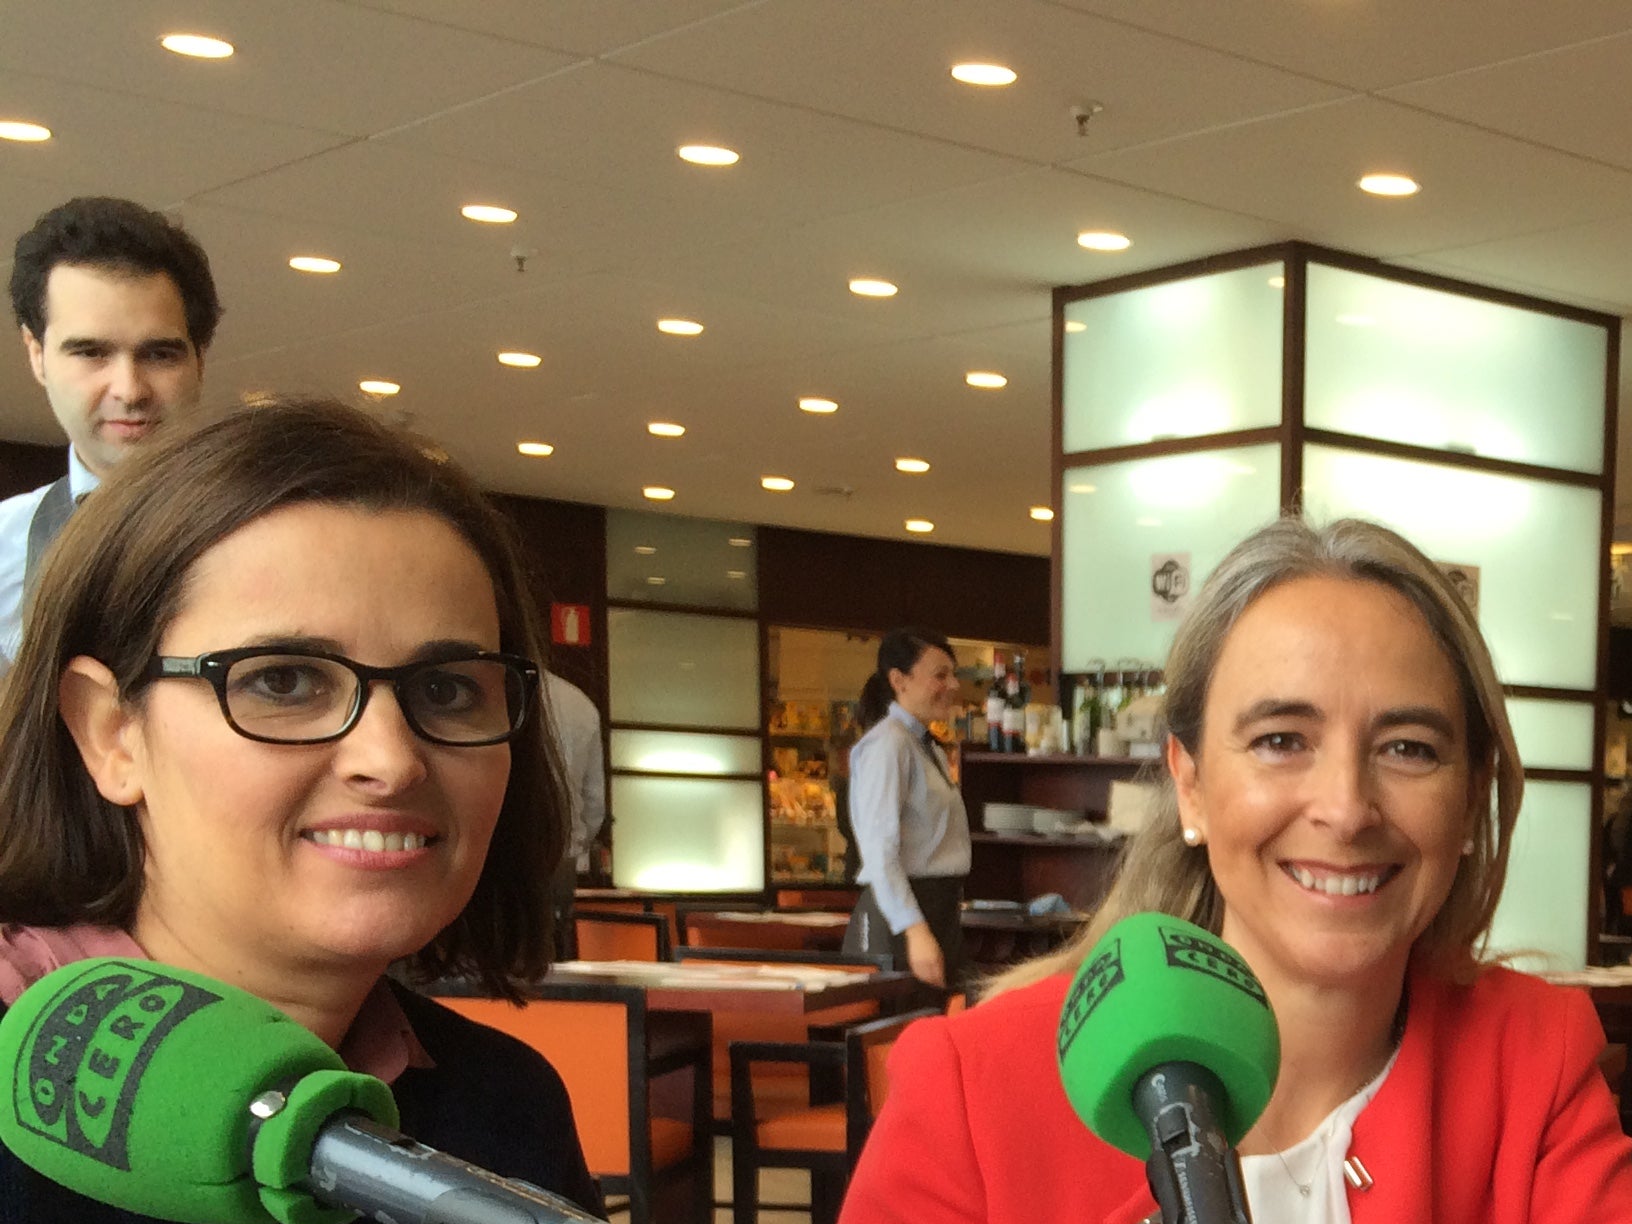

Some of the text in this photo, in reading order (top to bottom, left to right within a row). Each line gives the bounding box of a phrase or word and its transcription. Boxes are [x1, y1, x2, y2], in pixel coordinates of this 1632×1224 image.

[1187, 951, 1256, 990] CERO
[34, 982, 121, 1107] ONDA
[78, 993, 167, 1118] CERO
